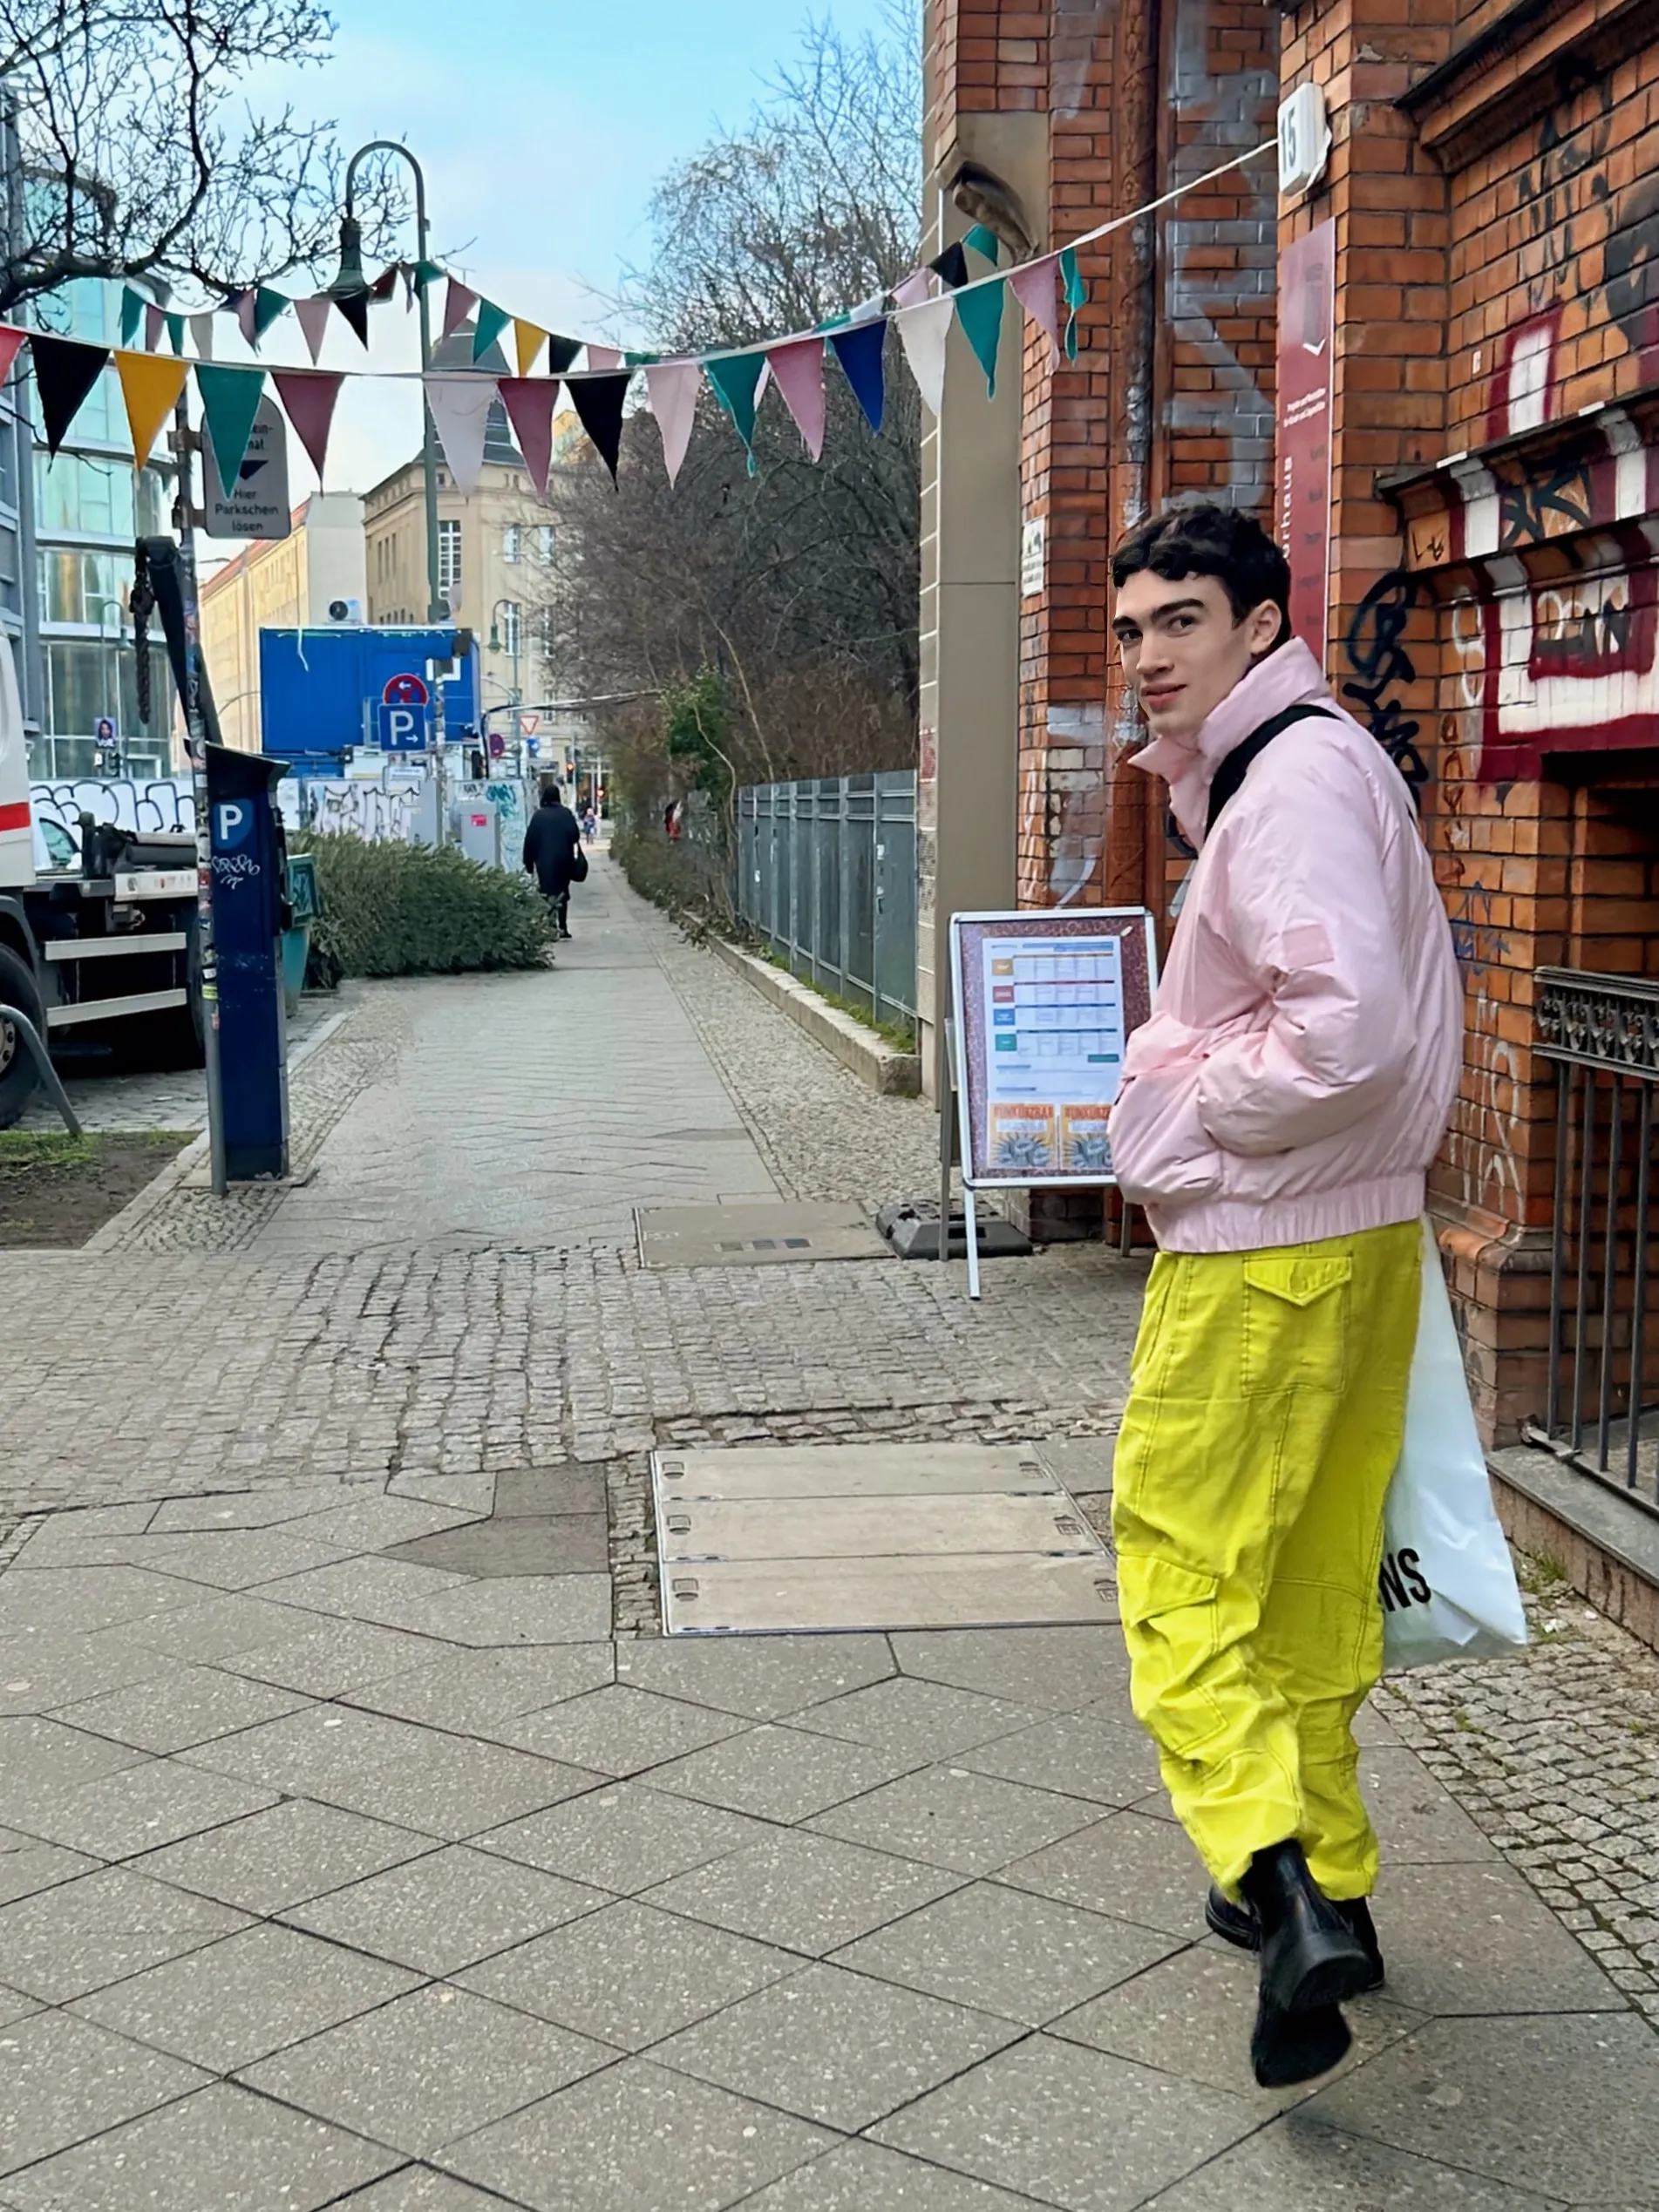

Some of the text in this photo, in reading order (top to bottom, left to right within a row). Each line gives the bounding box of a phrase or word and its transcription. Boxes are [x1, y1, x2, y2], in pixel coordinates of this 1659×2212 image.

[1281, 106, 1296, 173] 15
[214, 503, 279, 515] Parkschein
[234, 489, 257, 499] Hier
[232, 520, 263, 533] lösen
[390, 710, 414, 745] P
[219, 804, 243, 840] P
[1377, 1548, 1431, 1612] NS
